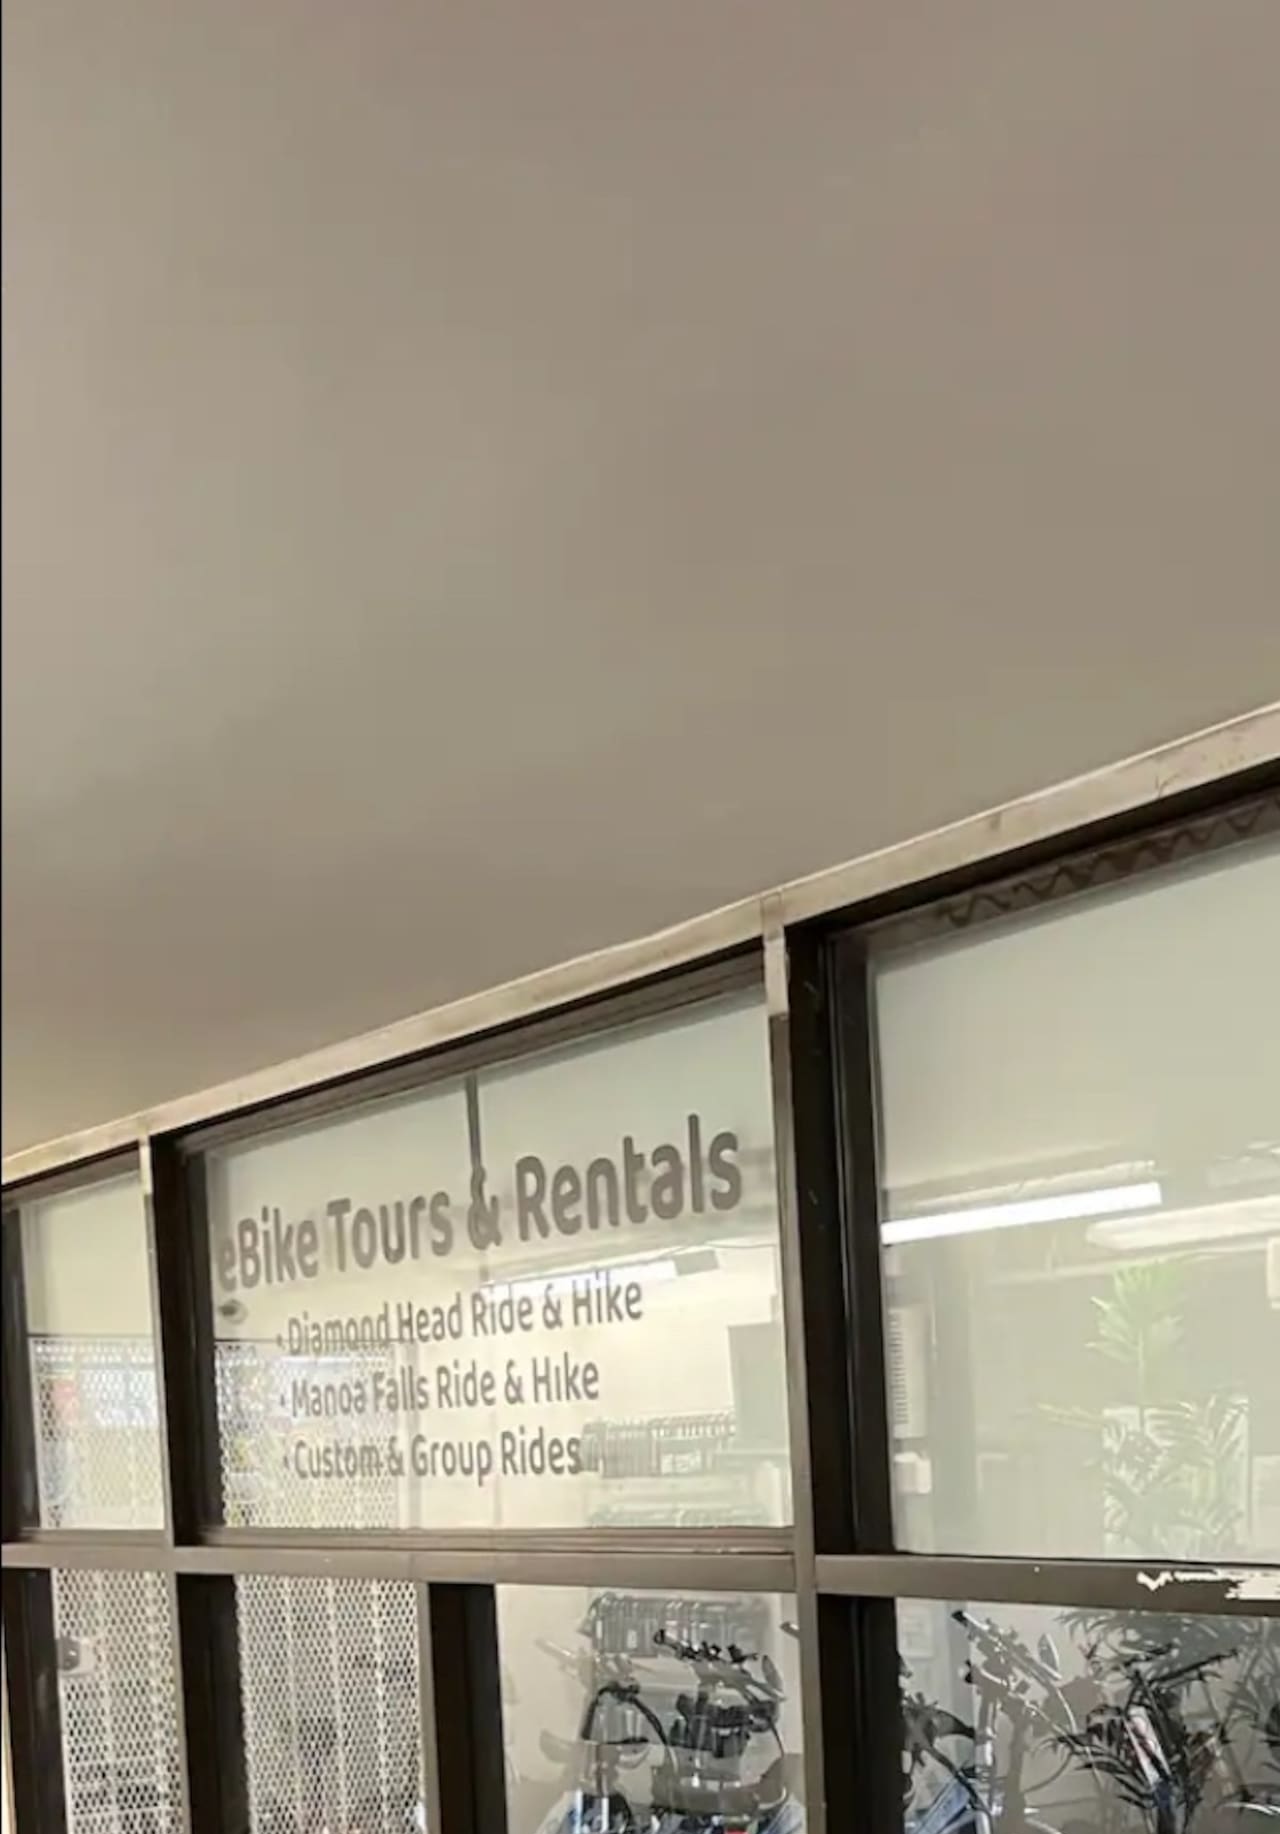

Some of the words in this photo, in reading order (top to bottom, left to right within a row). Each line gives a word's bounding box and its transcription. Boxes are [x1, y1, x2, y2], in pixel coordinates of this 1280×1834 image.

[216, 1205, 319, 1292] eBike
[327, 1190, 454, 1273] Tours
[466, 1164, 502, 1250] &
[516, 1114, 743, 1242] Rentals
[287, 1303, 391, 1357] Diamond
[400, 1292, 463, 1345] Head
[472, 1284, 533, 1334] Ride
[542, 1284, 564, 1328] &
[572, 1269, 644, 1326] Hike
[292, 1376, 366, 1419] Manoa
[373, 1364, 429, 1414] Falls
[437, 1356, 496, 1410] Ride
[504, 1359, 525, 1406] &
[532, 1352, 600, 1402] Hike
[294, 1436, 381, 1480] Custom
[386, 1435, 403, 1475] &
[411, 1432, 493, 1487] Group
[501, 1426, 583, 1477] Rides
